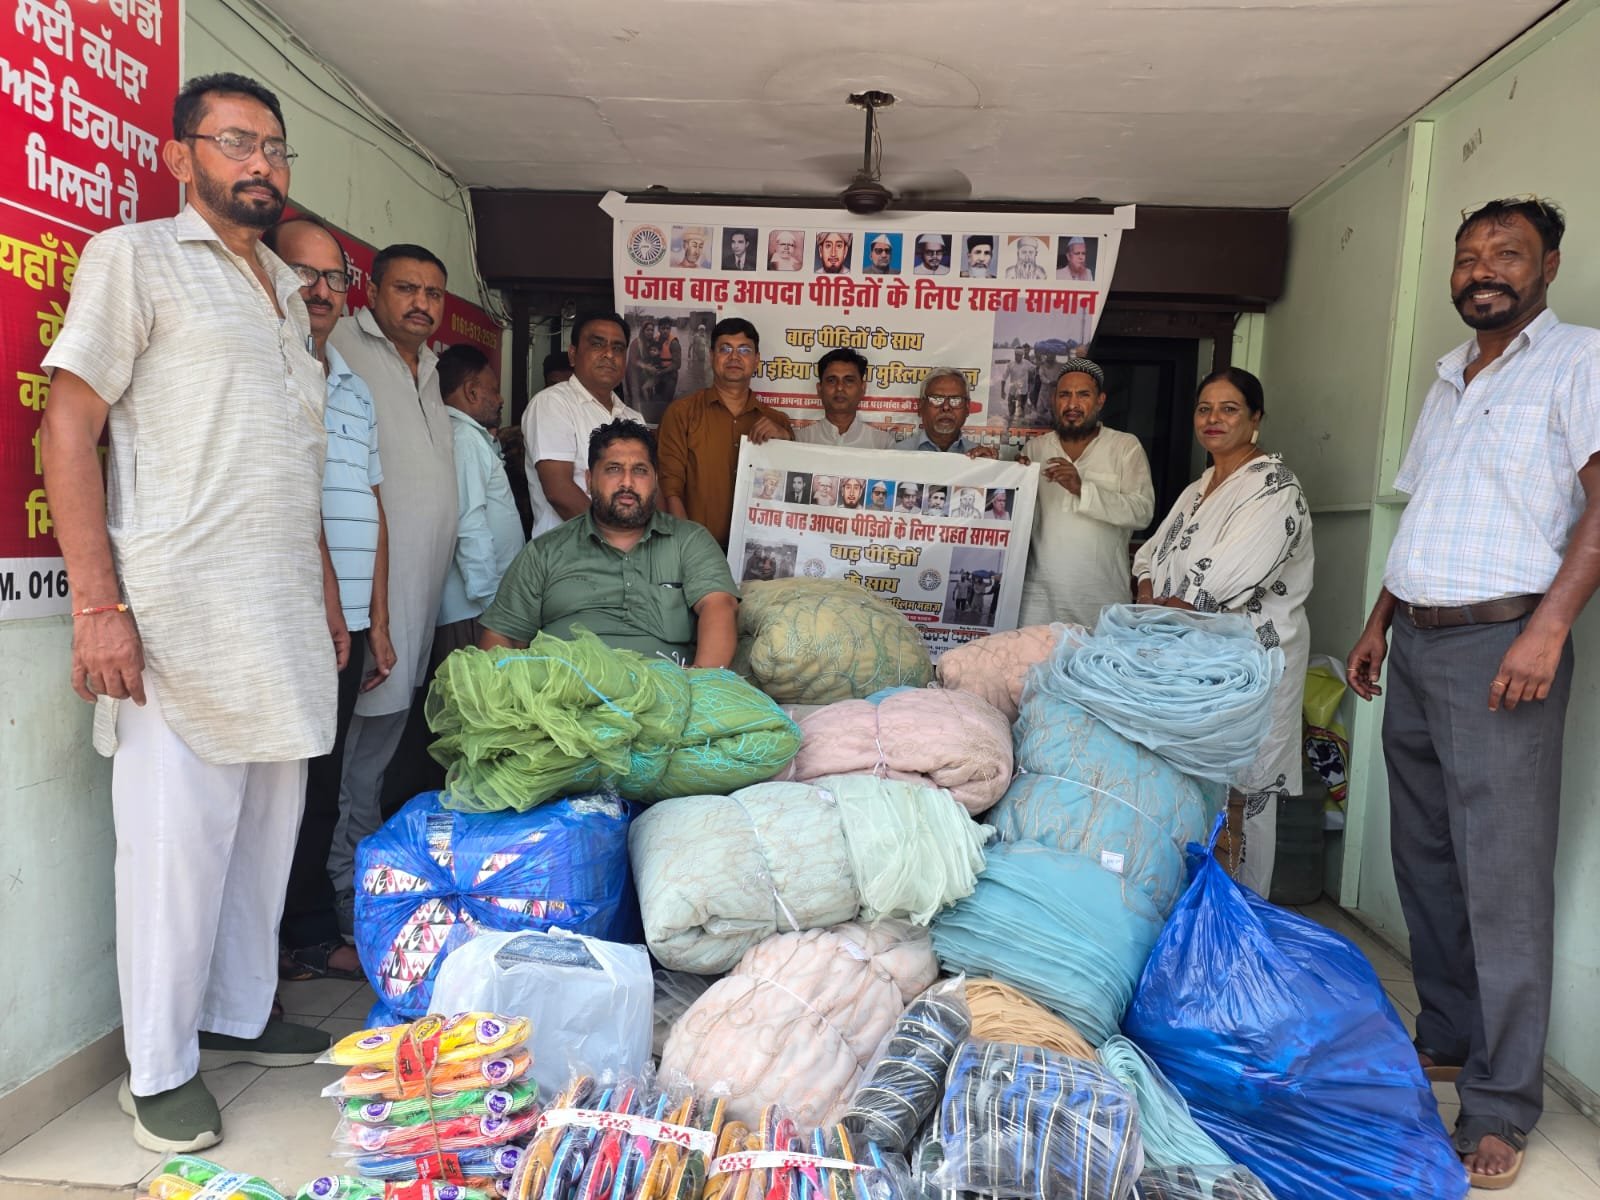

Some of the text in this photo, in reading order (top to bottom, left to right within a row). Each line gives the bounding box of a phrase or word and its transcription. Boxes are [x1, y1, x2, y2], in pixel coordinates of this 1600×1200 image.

[80, 24, 149, 104] ਕੱਪੜਾ
[60, 76, 159, 173] ਤਿਰਪਾਲ
[25, 132, 113, 219] ਮਿਲਦੀ
[624, 269, 1099, 315] पंजाब बाढ़ आपदा पीड़ितों के लिए राहत सामान
[786, 328, 816, 352] बाढ़
[871, 326, 889, 349] के
[891, 331, 924, 351] साथ
[766, 356, 813, 381] इंडिया
[749, 502, 1011, 547] पंजाब बाढ़ आपदा पीड़ितों के लिए राहत सामान
[830, 543, 922, 569] बाढ़ पीड़ितों
[29, 569, 70, 600] 016
[865, 575, 900, 593] साथ
